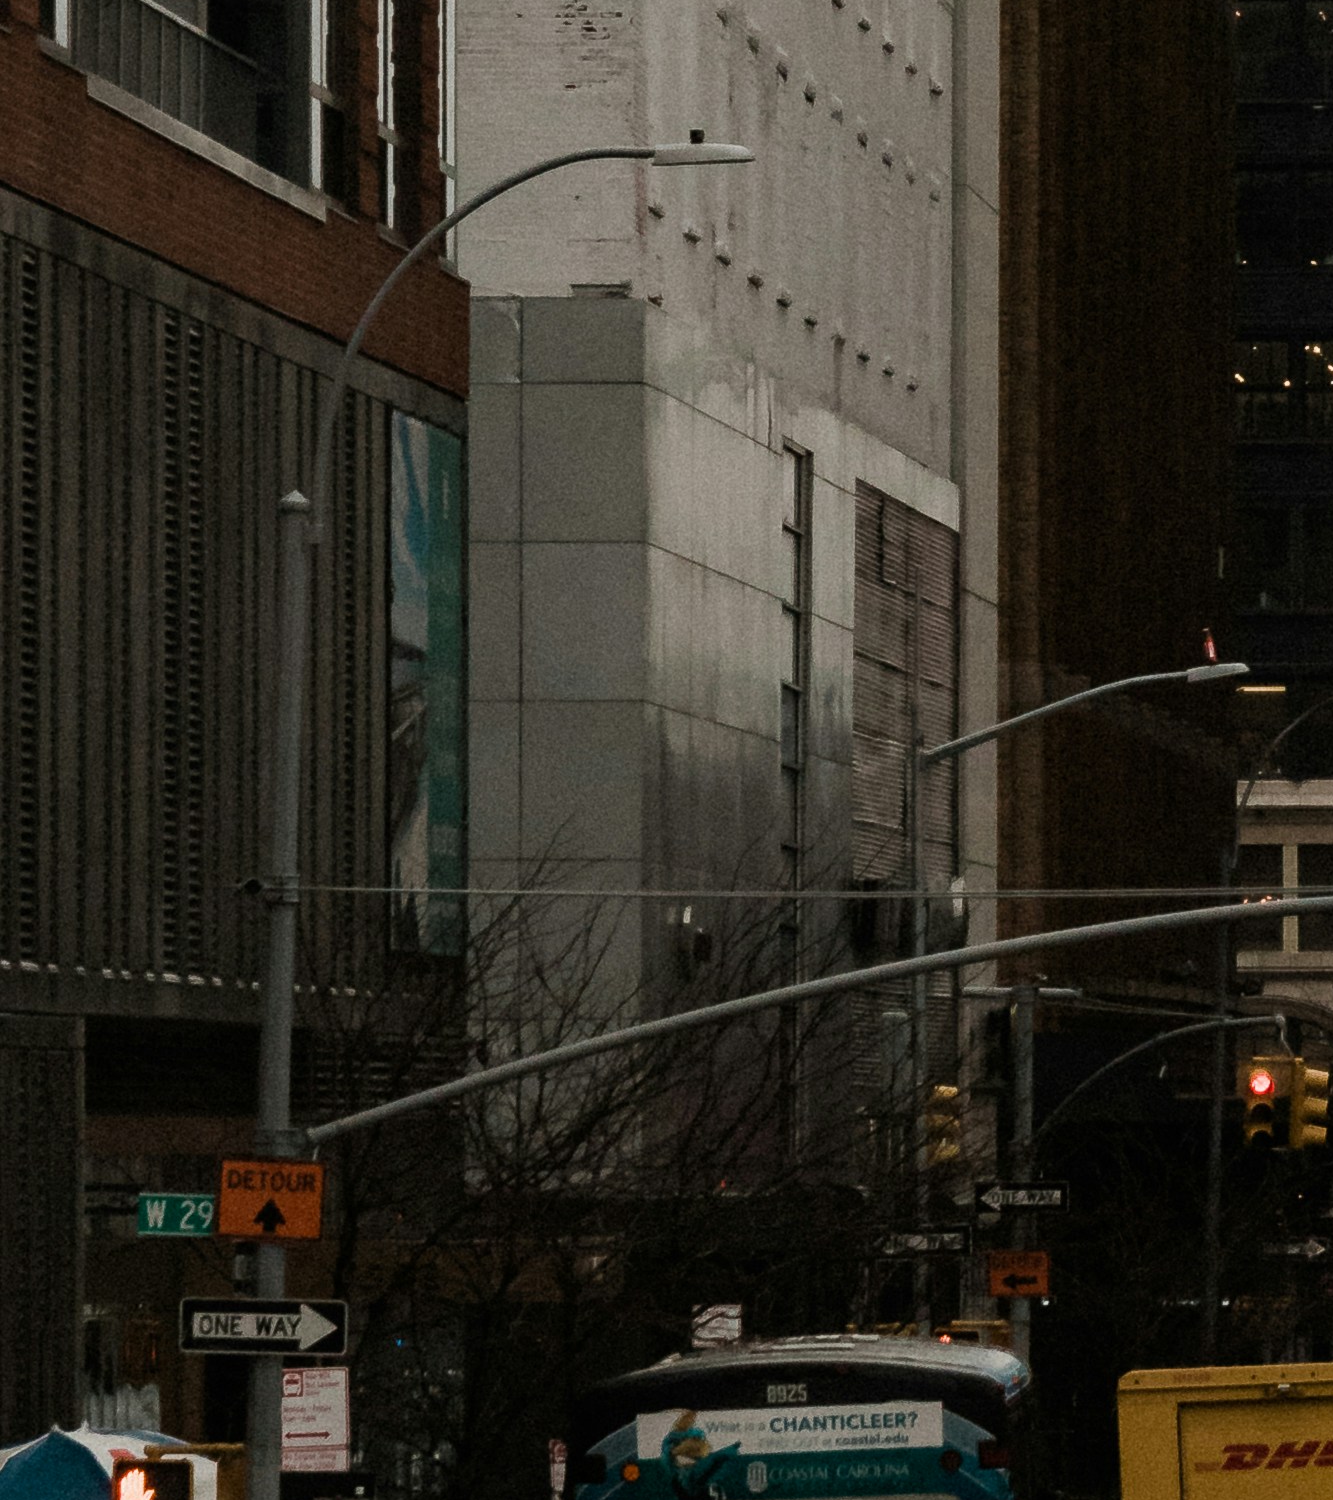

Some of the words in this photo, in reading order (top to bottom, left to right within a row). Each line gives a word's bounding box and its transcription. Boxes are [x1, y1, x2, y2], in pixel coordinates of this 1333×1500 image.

[226, 1168, 316, 1193] DETOUR
[145, 1200, 167, 1231] W
[179, 1199, 214, 1231] 29
[200, 1315, 242, 1336] ONE
[255, 1315, 301, 1337] WAY
[770, 1411, 918, 1434] CHANTICLEER?
[769, 1465, 829, 1482] COASTAL
[836, 1463, 910, 1480] CAROLINA
